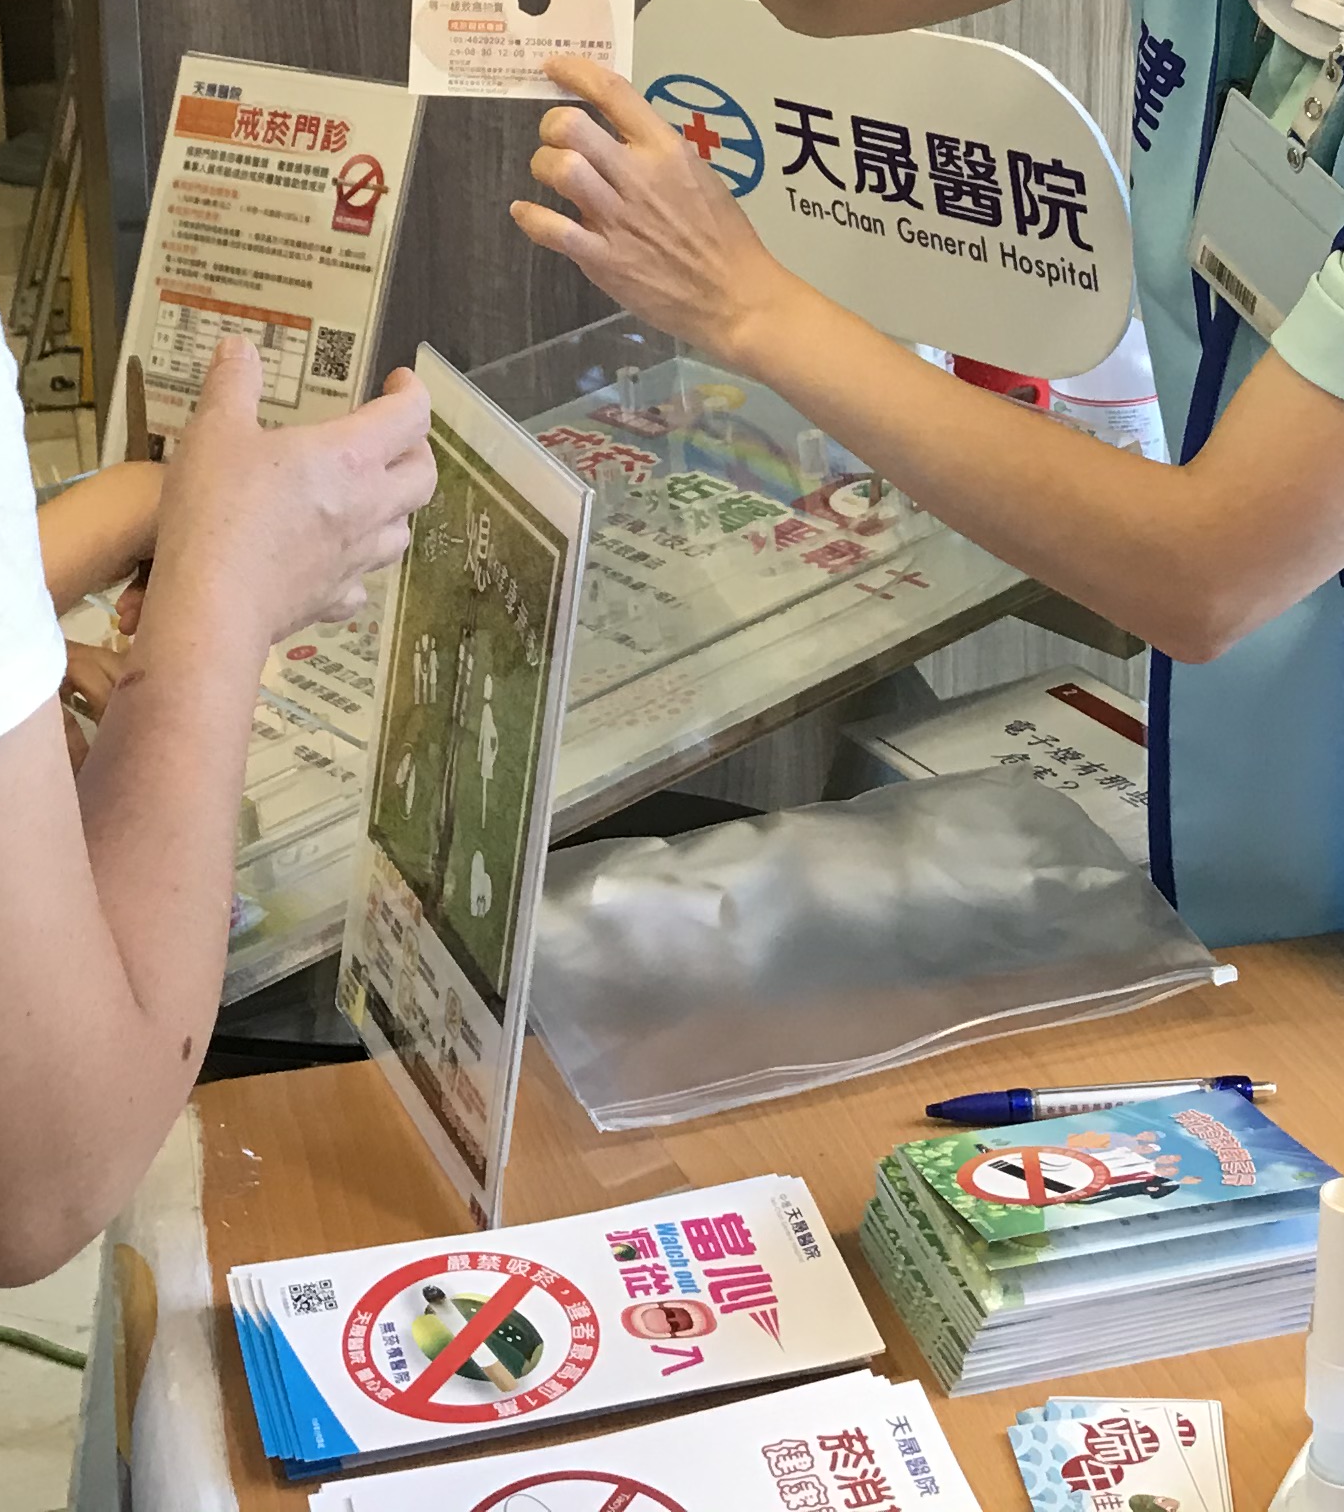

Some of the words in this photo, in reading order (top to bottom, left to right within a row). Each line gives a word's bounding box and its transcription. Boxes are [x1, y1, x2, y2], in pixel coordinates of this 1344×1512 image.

[233, 105, 351, 154] 戒菸門診
[773, 97, 1095, 252] 天晟醫院
[785, 187, 885, 237] Ten-Chan
[897, 218, 988, 264] General
[1000, 241, 1099, 292] Hospital
[654, 1221, 690, 1268] Watch
[674, 1264, 702, 1294] out
[680, 1212, 779, 1315] 當心
[762, 1438, 837, 1512] 健康
[816, 1426, 903, 1512] 菸消
[886, 1414, 941, 1498] 天晟醫院
[1062, 1418, 1159, 1492] 端午
